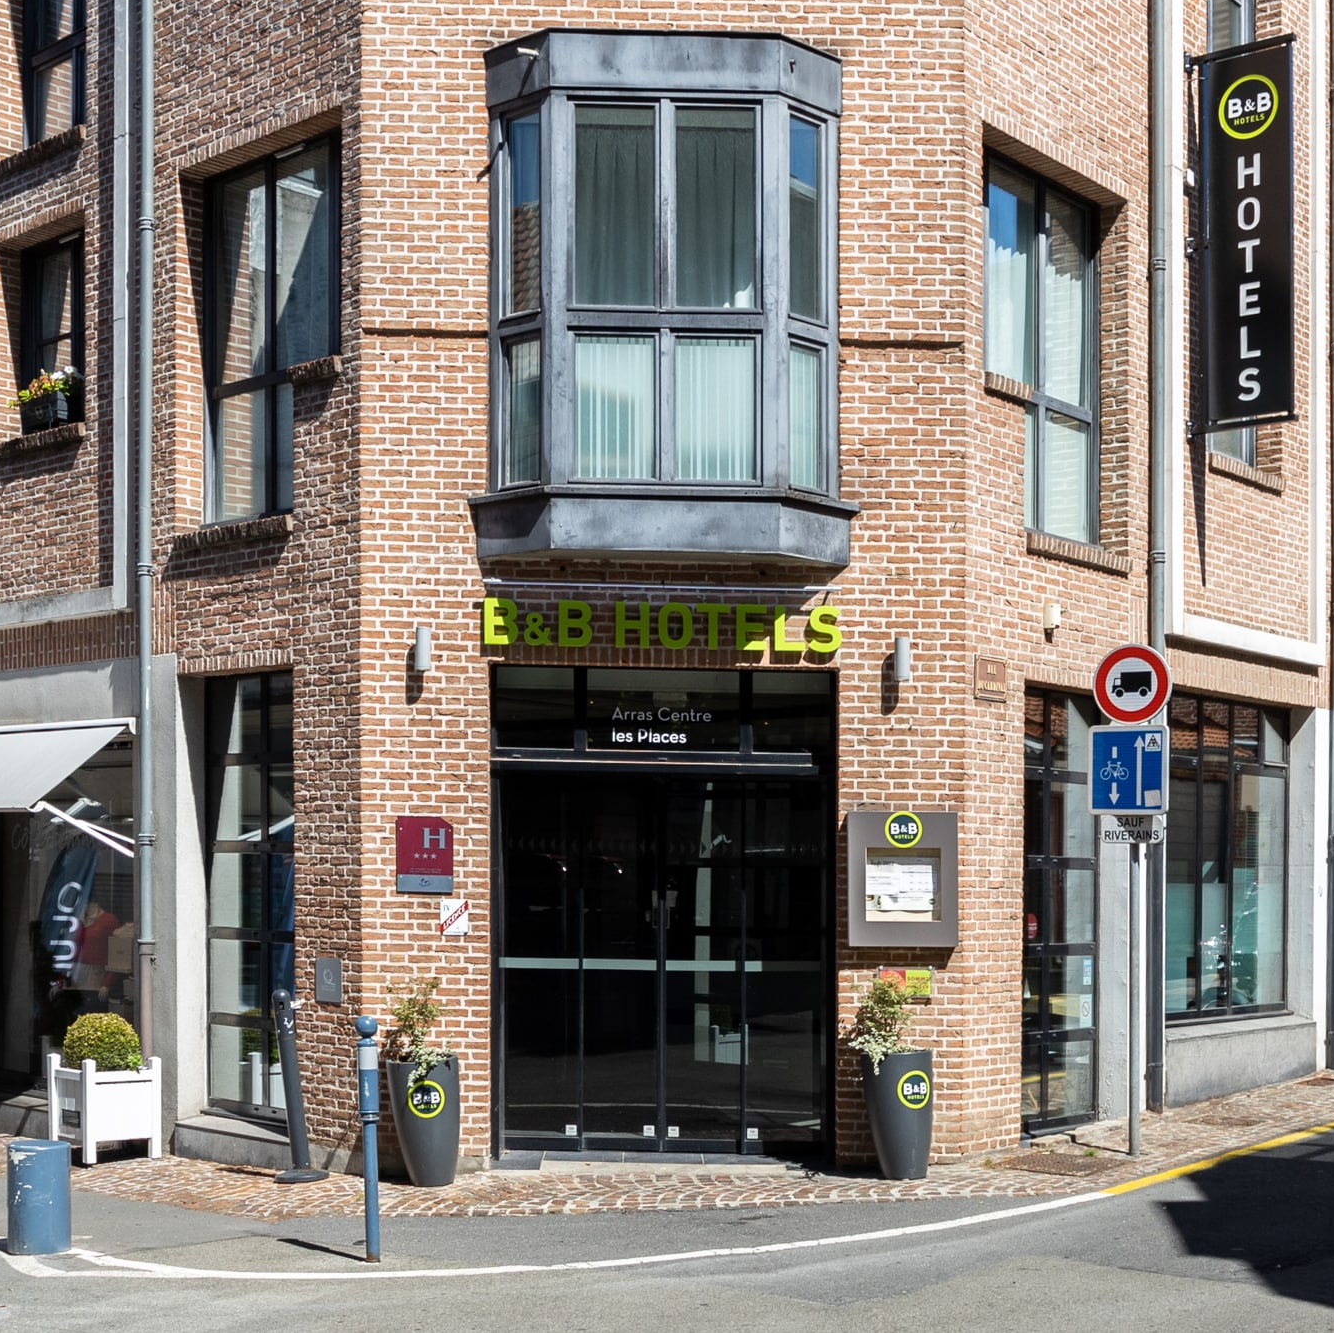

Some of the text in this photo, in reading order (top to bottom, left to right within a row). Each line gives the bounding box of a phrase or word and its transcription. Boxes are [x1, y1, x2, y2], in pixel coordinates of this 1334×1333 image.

[1227, 91, 1272, 117] B&B
[1233, 113, 1265, 126] HOTELS
[1237, 152, 1261, 402] HOTELS
[483, 597, 842, 653] B&B HOTELS
[611, 707, 712, 723] Arras Centre
[611, 730, 687, 744] les Places
[890, 822, 918, 835] B&B
[1117, 817, 1144, 827] SAUF
[423, 828, 446, 849] H
[1104, 830, 1160, 840] RIVERAINS
[903, 1082, 927, 1095] B&B
[413, 1092, 440, 1104] B&B
